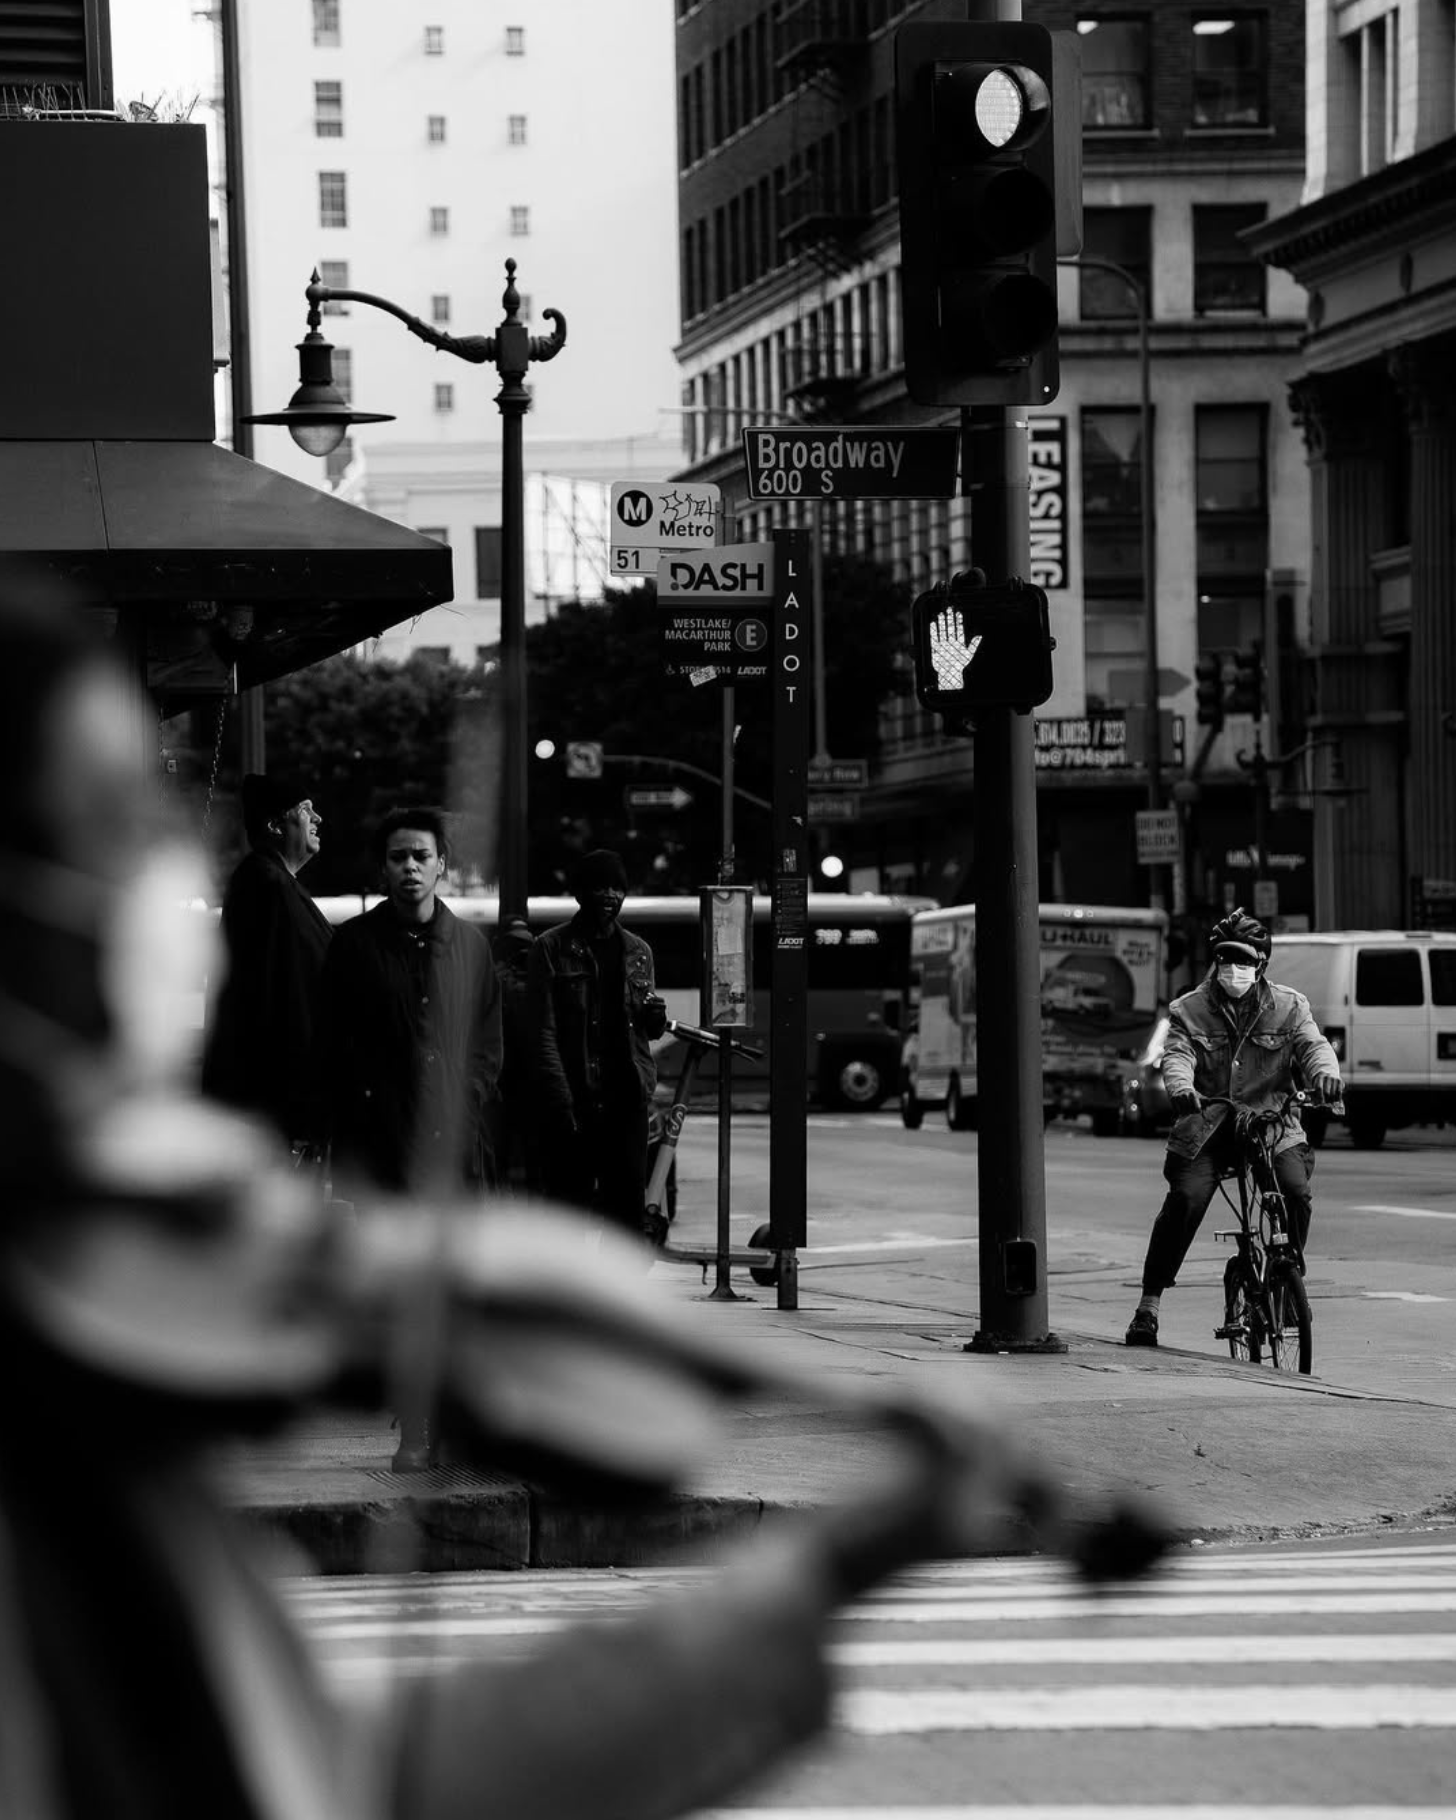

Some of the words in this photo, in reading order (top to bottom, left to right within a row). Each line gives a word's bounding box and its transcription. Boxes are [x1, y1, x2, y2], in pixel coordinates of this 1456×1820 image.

[757, 433, 905, 479] Broadway
[757, 469, 802, 495] 600
[819, 469, 834, 495] S
[623, 497, 647, 521] M
[1028, 418, 1063, 588] LEASING
[659, 520, 715, 538] Metro
[616, 550, 640, 570] 51
[670, 561, 765, 592] DASH
[664, 629, 732, 641] MACARTHUR
[672, 618, 732, 629] WESTLAKE/
[745, 624, 758, 646] E
[782, 559, 800, 703] LADOT
[703, 641, 732, 652] PARK
